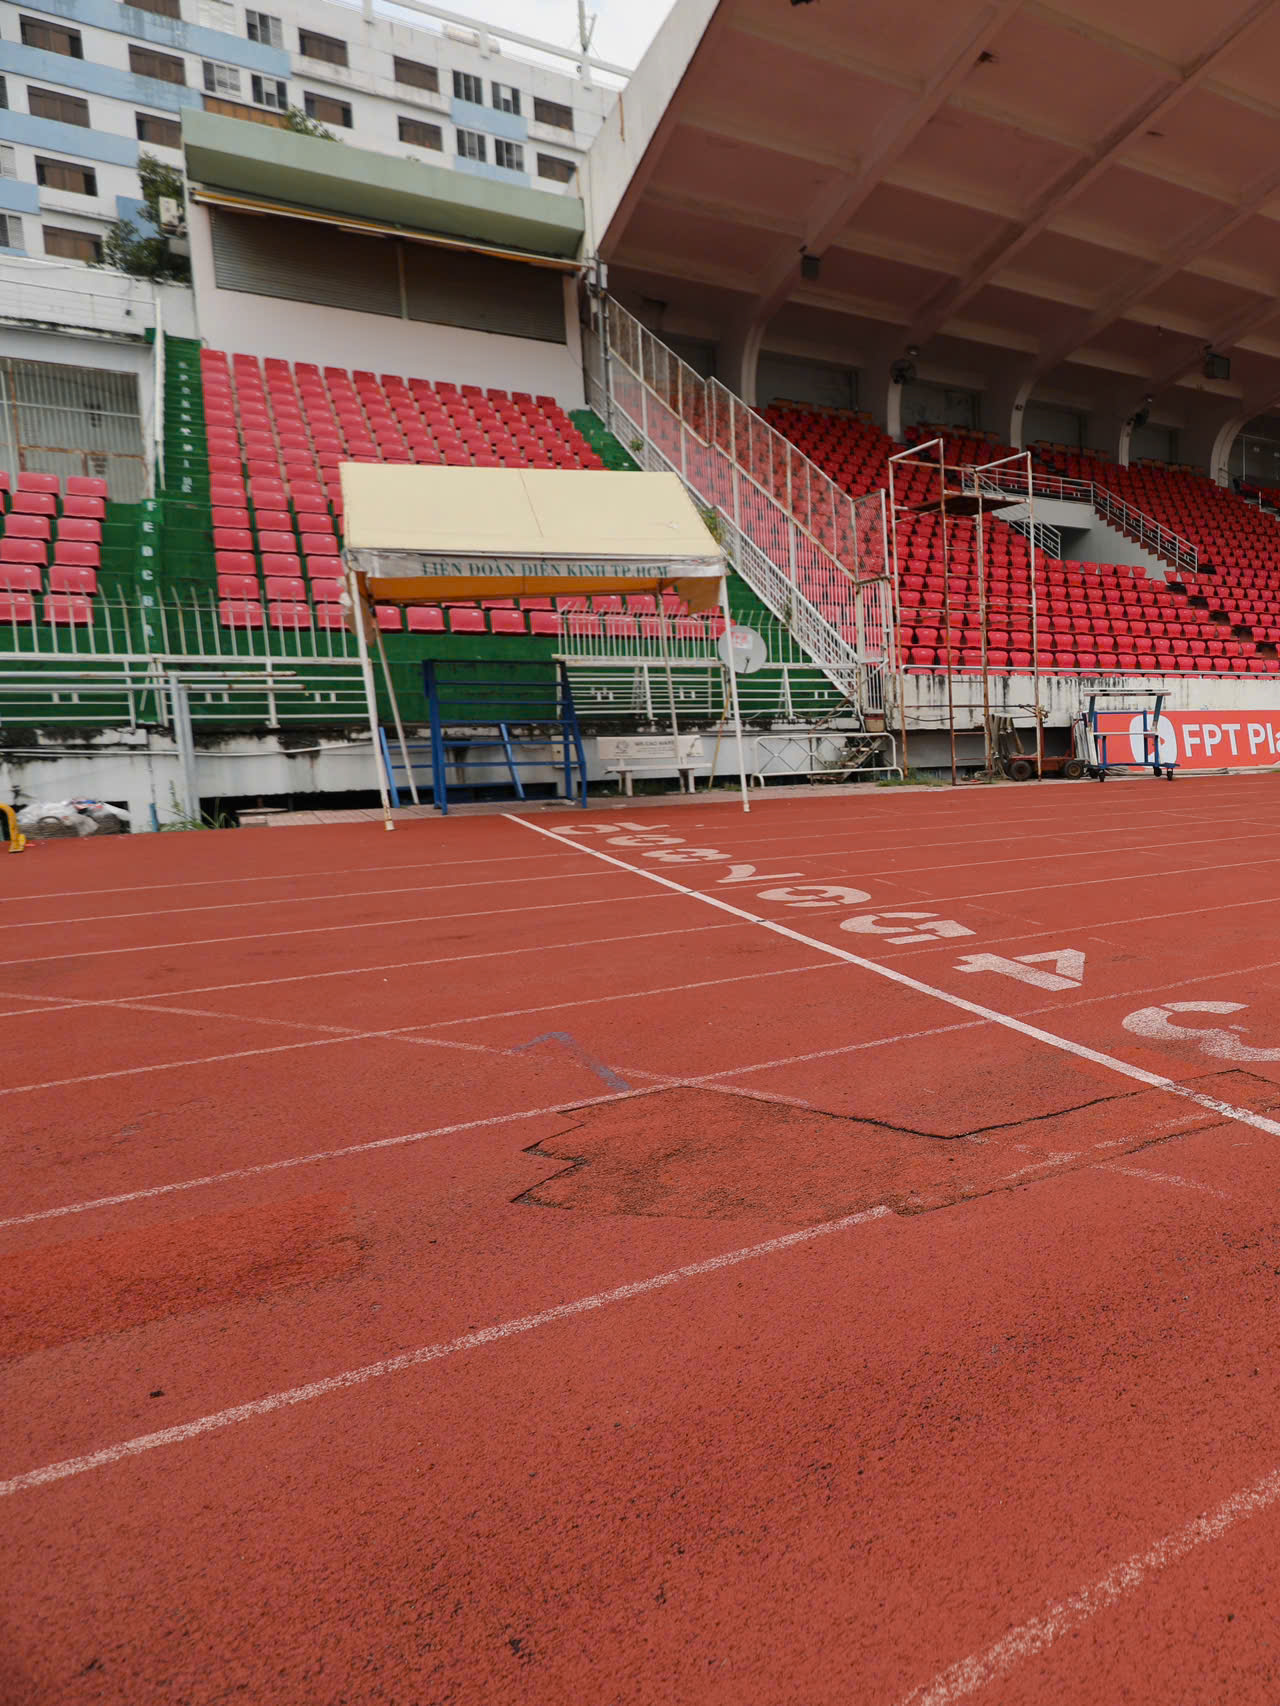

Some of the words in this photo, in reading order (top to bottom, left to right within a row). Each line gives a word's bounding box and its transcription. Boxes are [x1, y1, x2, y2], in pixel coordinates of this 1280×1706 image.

[142, 521, 154, 532] E
[422, 558, 462, 576] LIÊN
[567, 563, 607, 577] KINH
[611, 564, 669, 579] TP.HCM
[1181, 723, 1241, 757] FPT
[716, 864, 805, 883] 7
[839, 912, 977, 945] 5
[952, 948, 1086, 991] 4
